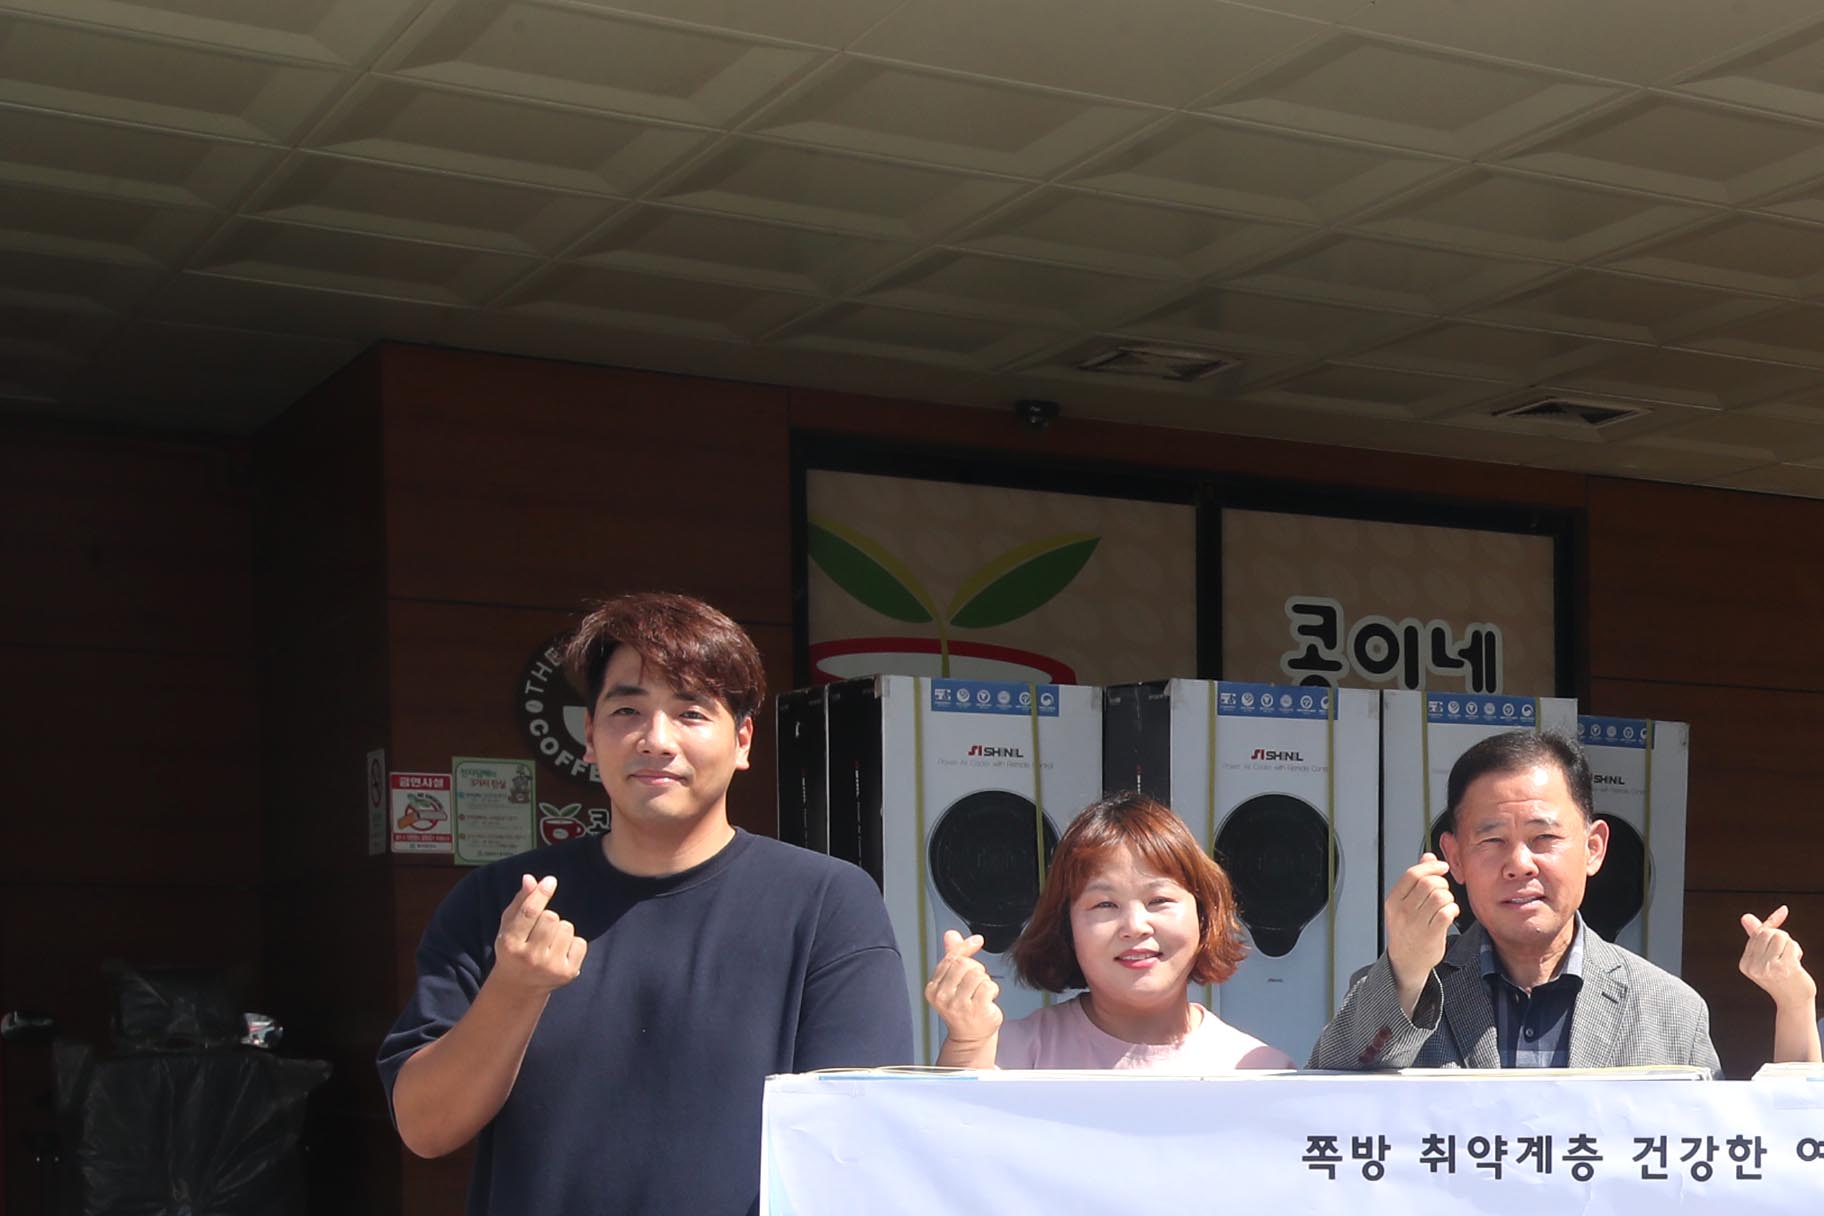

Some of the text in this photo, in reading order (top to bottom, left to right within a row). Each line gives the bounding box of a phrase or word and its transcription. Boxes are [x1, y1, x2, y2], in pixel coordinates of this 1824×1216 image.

[1286, 601, 1497, 694] 콩이네
[399, 777, 445, 789] 금연시설
[1301, 1134, 1392, 1181] 쪽방
[1418, 1131, 1604, 1179] 취약계층
[1631, 1133, 1766, 1181] 건강한
